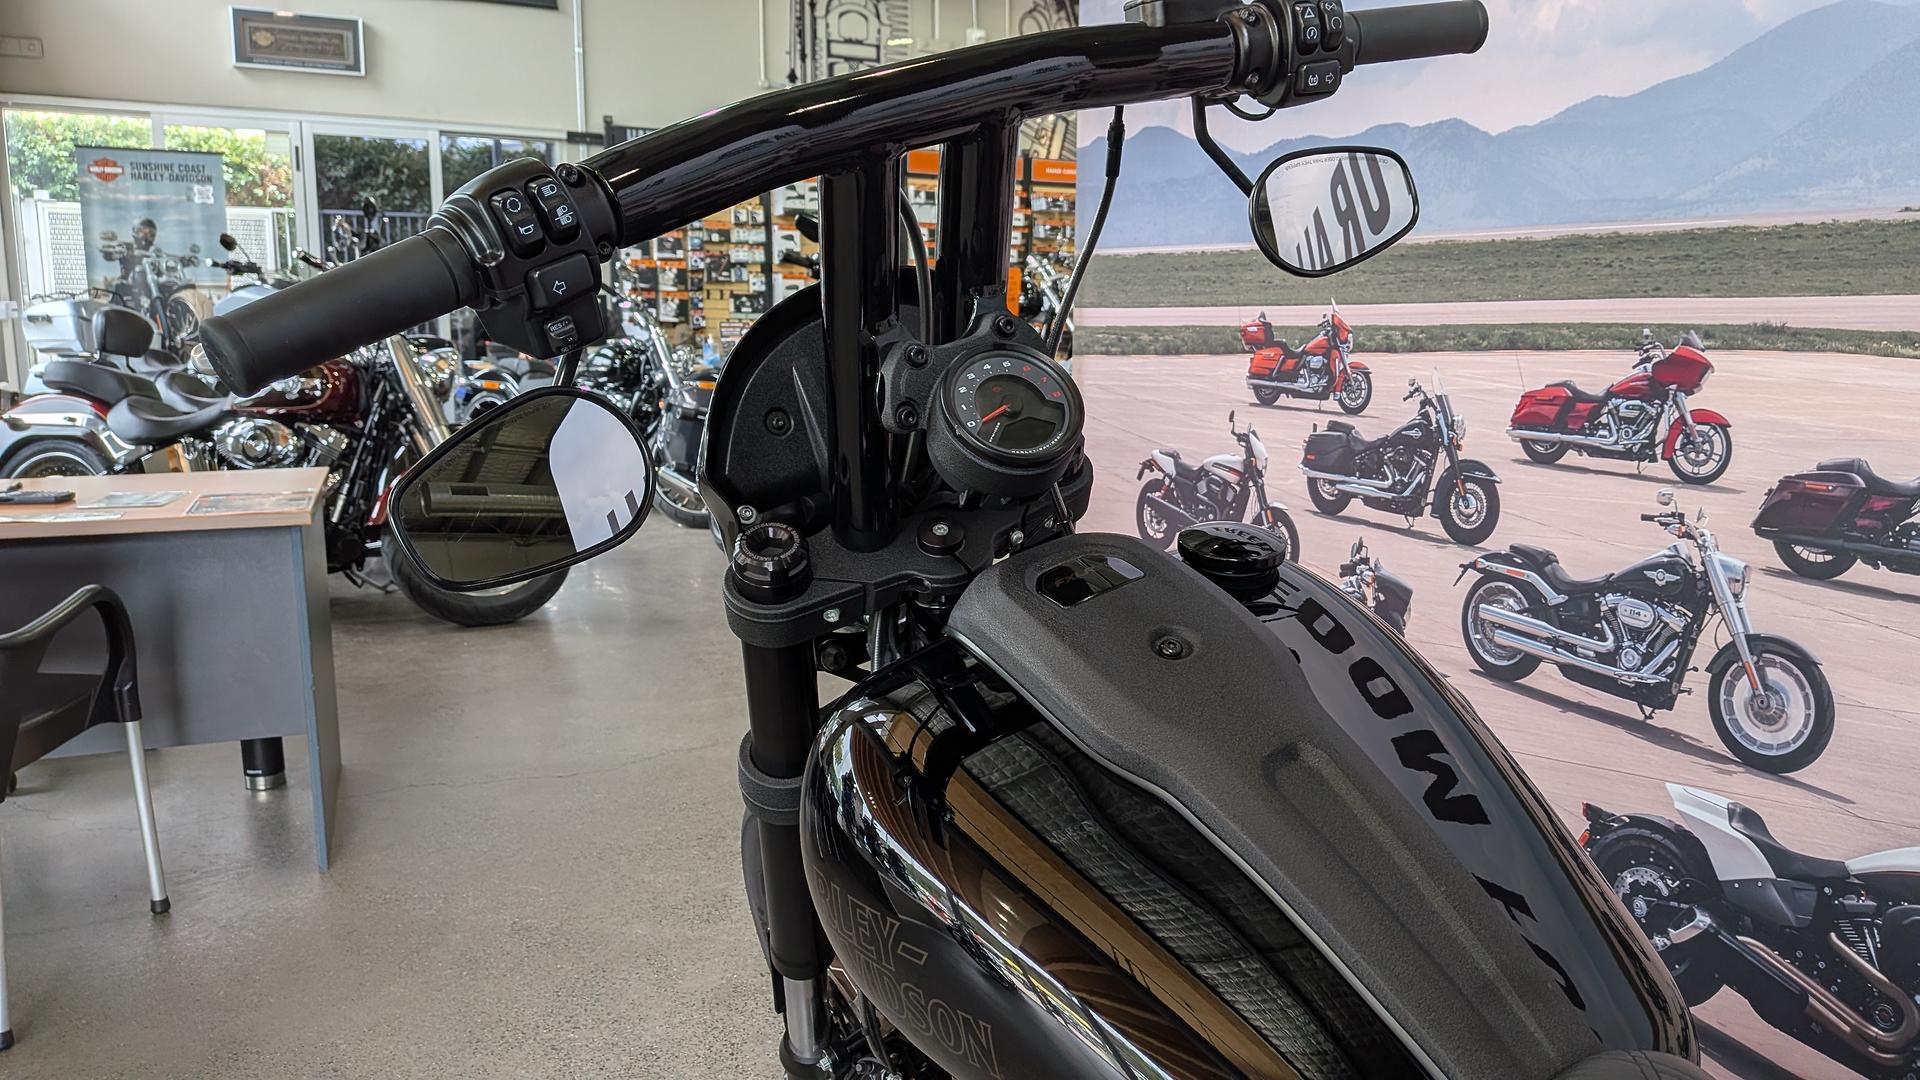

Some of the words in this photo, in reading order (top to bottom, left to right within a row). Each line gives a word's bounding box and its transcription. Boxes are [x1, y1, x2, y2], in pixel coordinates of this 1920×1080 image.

[130, 161, 174, 171] SUNSHINE
[178, 164, 205, 173] COAST
[130, 172, 212, 184] HARLEY-DAVIDSON
[1629, 609, 1641, 617] 114
